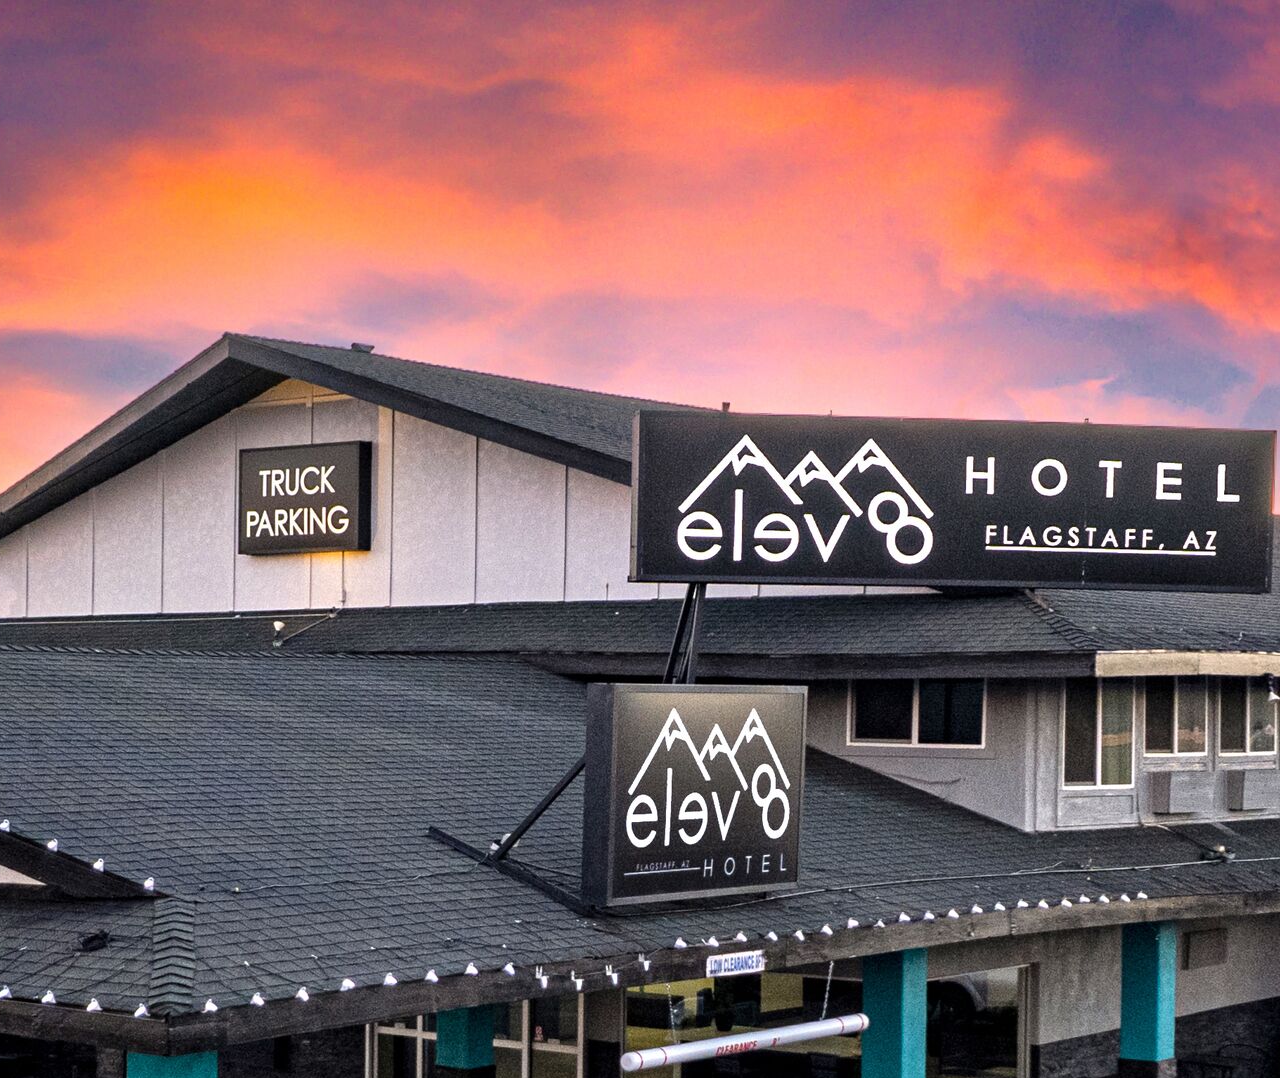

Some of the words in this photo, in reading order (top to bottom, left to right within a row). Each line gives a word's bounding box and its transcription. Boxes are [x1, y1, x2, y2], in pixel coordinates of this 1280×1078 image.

[258, 465, 336, 498] TRUCK
[966, 455, 1241, 503] HOTEL
[245, 505, 350, 538] PARKING
[1183, 530, 1218, 551] AZ
[703, 853, 787, 877] HOTEL
[715, 1040, 758, 1057] CLEARANCE
